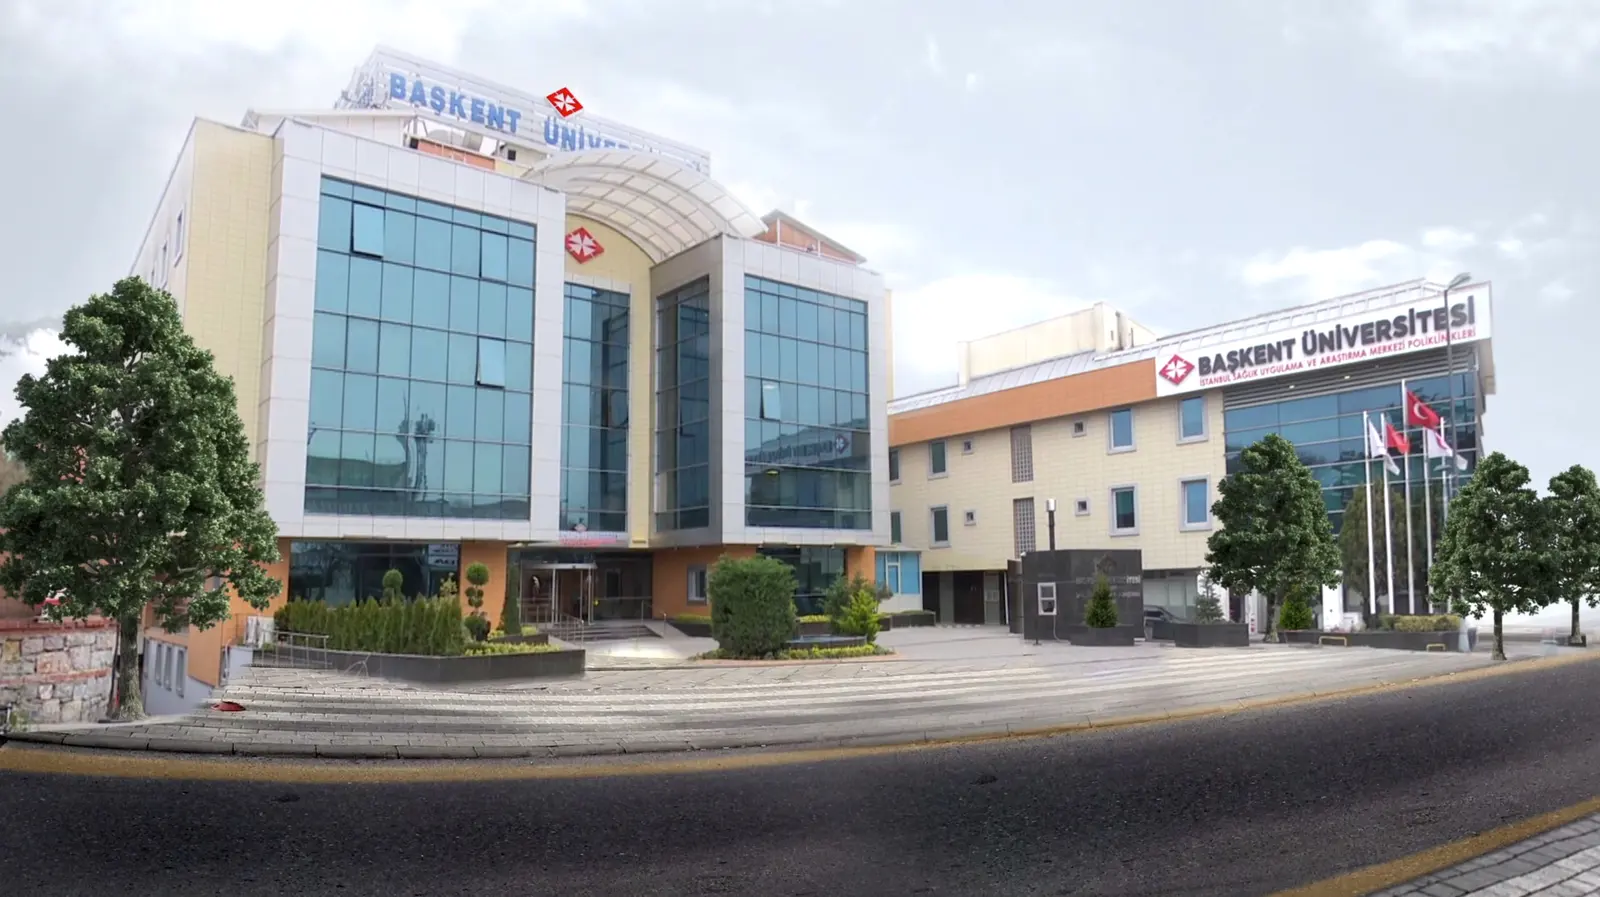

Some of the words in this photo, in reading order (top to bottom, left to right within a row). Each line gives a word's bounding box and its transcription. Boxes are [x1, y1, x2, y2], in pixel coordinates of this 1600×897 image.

[390, 72, 522, 133] BAŞKENT
[1198, 338, 1296, 376] BAŞKENT
[1302, 295, 1476, 356] ÜNİVERSİTESİ
[1199, 374, 1231, 386] İSTANBUL
[1260, 361, 1303, 376] UYGULAMA
[1307, 357, 1317, 367] VE
[1320, 350, 1367, 365] ARAŞTIRMA
[1370, 343, 1406, 356] MERKEZİ
[1408, 327, 1476, 348] POLİKLİNKLERİ
